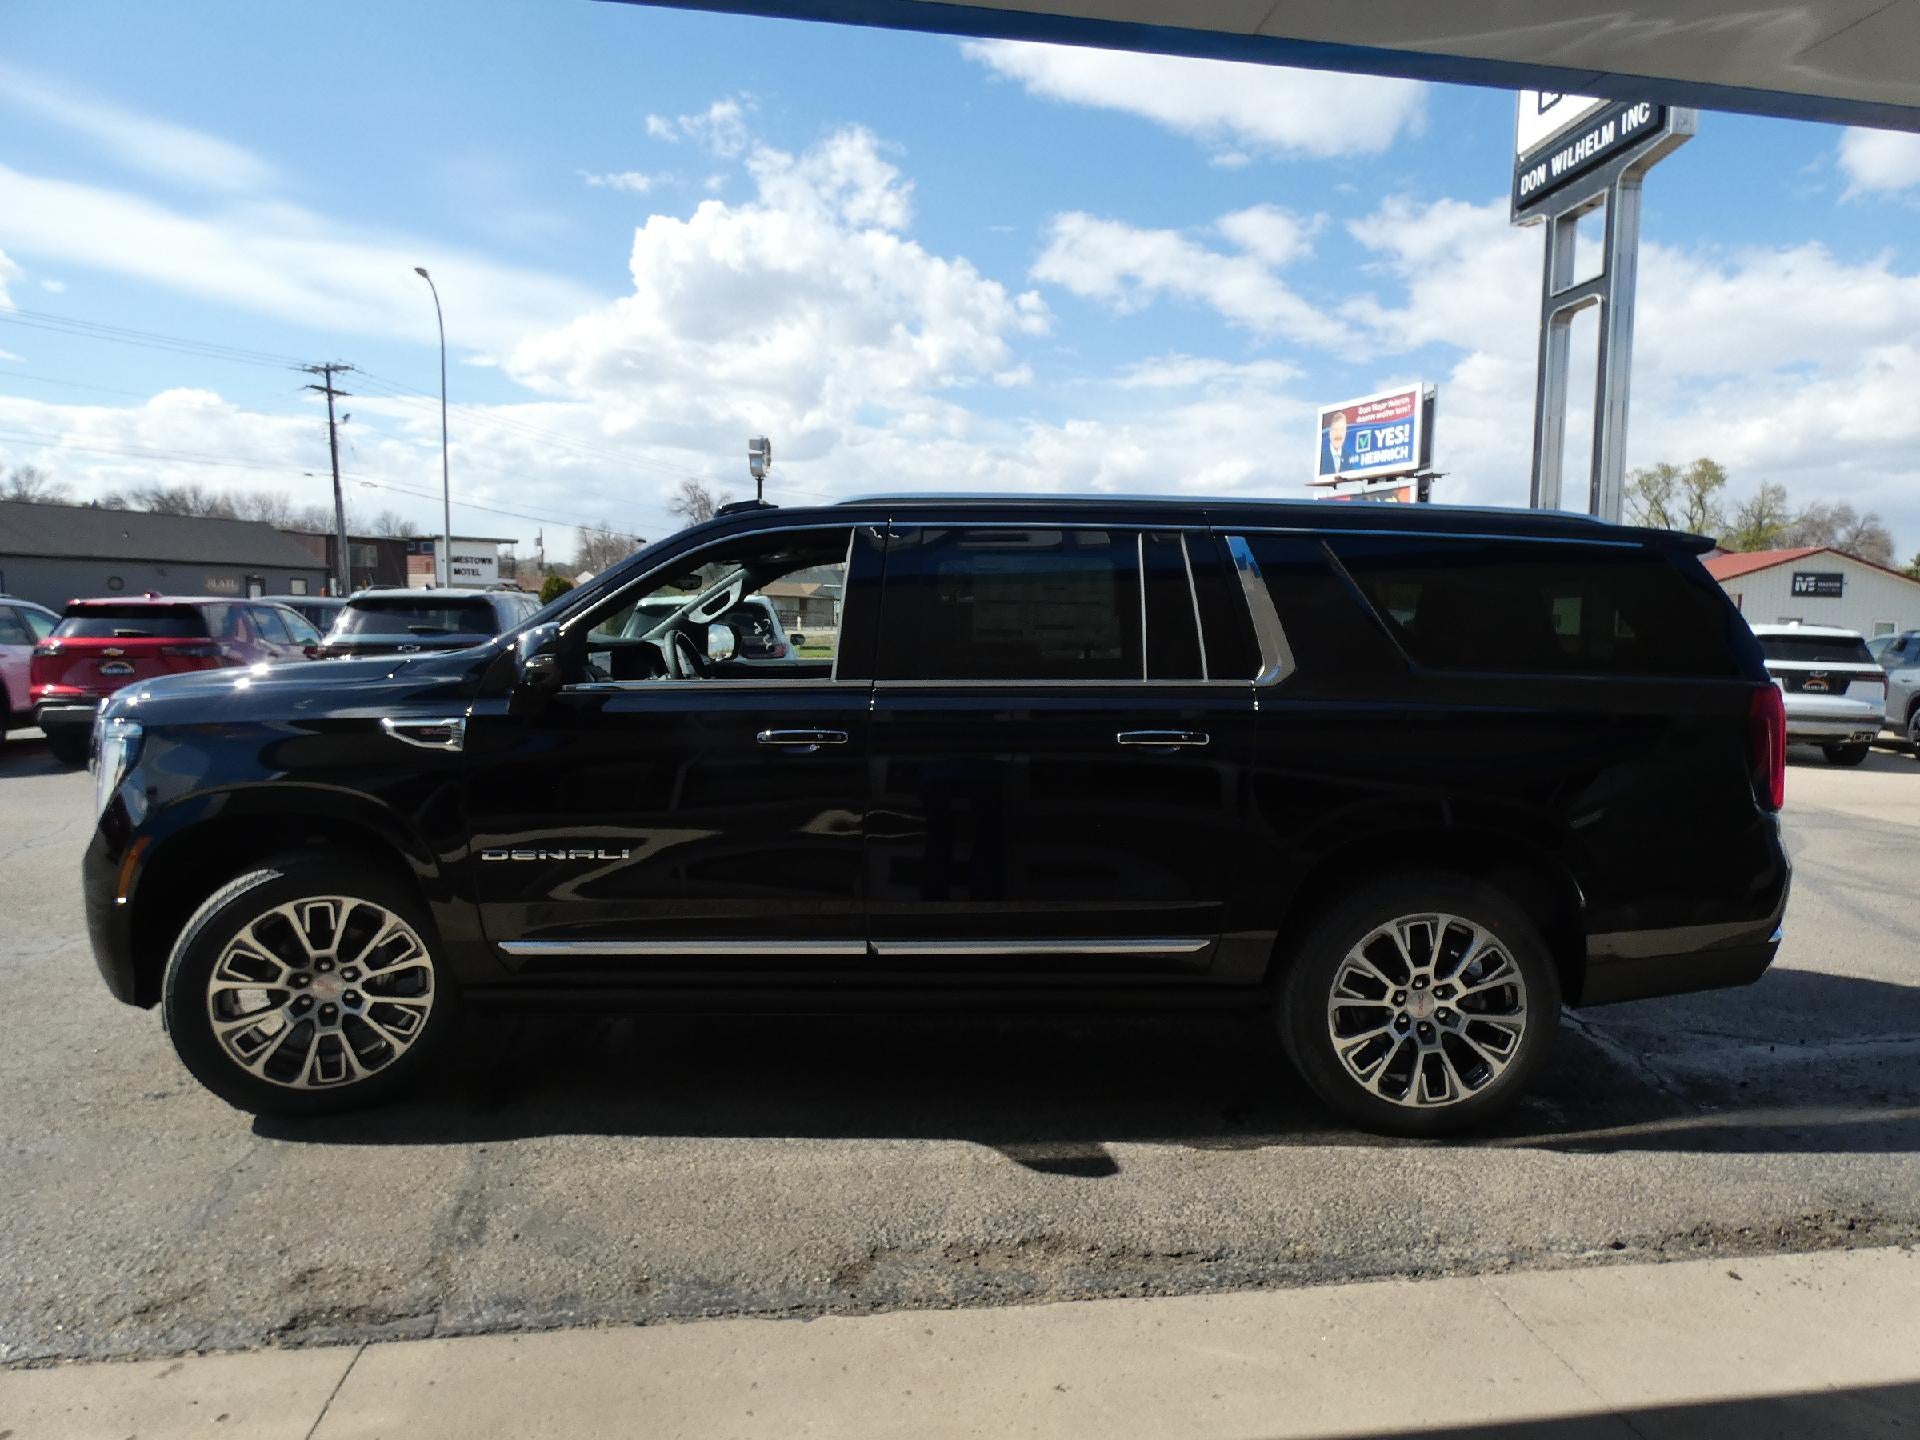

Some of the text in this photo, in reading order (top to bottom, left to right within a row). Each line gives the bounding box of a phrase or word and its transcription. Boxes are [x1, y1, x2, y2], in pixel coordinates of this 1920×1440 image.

[1520, 102, 1650, 196] DON WILHELM INC
[1374, 424, 1410, 448] YES!
[1360, 446, 1409, 466] HEINRICH
[450, 556, 493, 565] MESTOWN
[453, 568, 481, 576] MOTEL
[481, 849, 630, 861] DENALI
